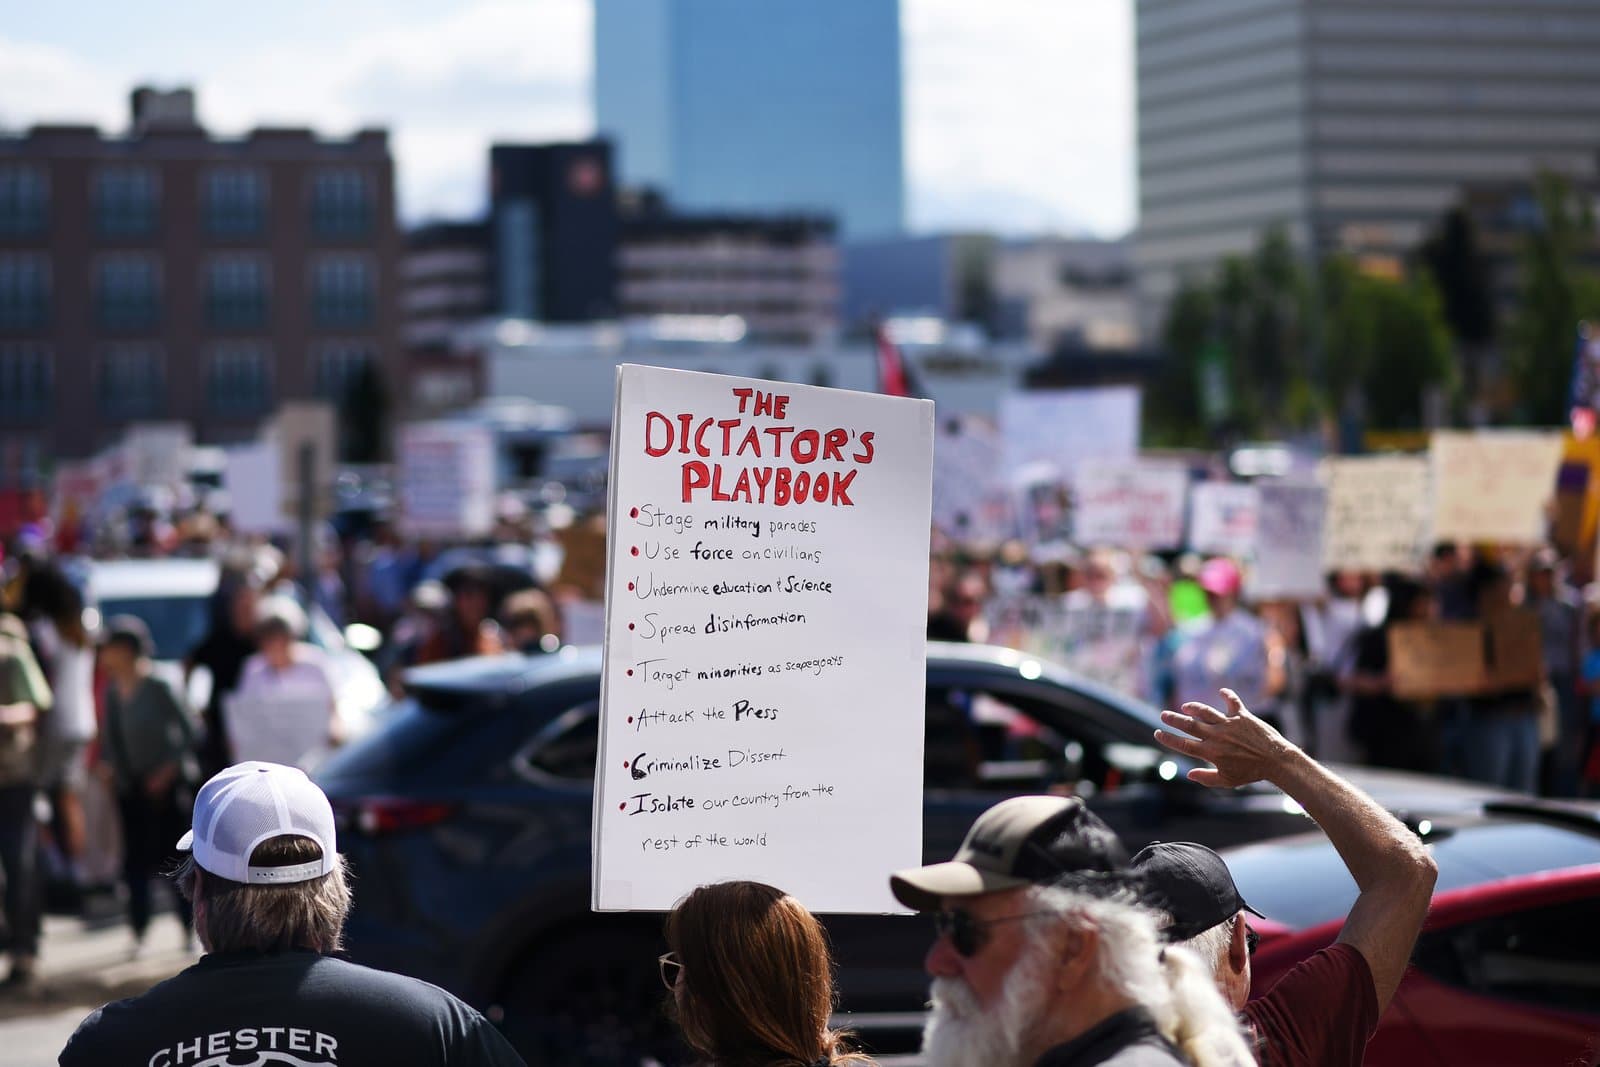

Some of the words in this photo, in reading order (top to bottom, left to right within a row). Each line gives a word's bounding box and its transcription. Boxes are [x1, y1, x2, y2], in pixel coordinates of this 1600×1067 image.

[732, 387, 790, 420] THE
[643, 410, 876, 465] DICTATOR'S
[681, 460, 858, 507] PLAYBOOK
[636, 503, 693, 535] Stage
[704, 514, 760, 538] military
[769, 519, 817, 538] parades
[644, 541, 680, 561] Use
[690, 540, 734, 560] force
[741, 550, 761, 560] on
[635, 571, 709, 600] Undermine
[712, 581, 773, 595] education
[784, 575, 832, 594] Science
[640, 612, 697, 644] Spread
[704, 612, 806, 635] disinformation
[636, 658, 692, 690] Target
[697, 663, 762, 681] minorities
[767, 664, 782, 674] as
[785, 655, 844, 677] scapegoats
[636, 707, 696, 732] Attack
[702, 707, 726, 720] the
[732, 699, 779, 721] Press
[630, 752, 723, 781] Criminalize
[728, 748, 787, 768] Dissent
[628, 793, 696, 816] Isolate
[702, 799, 729, 811] our
[732, 792, 780, 808] country
[782, 784, 811, 799] from
[812, 783, 835, 796] the
[641, 833, 680, 852] rest
[684, 835, 702, 849] of
[705, 833, 729, 847] the
[733, 832, 768, 847] world
[148, 1026, 339, 1067] CHESTER
